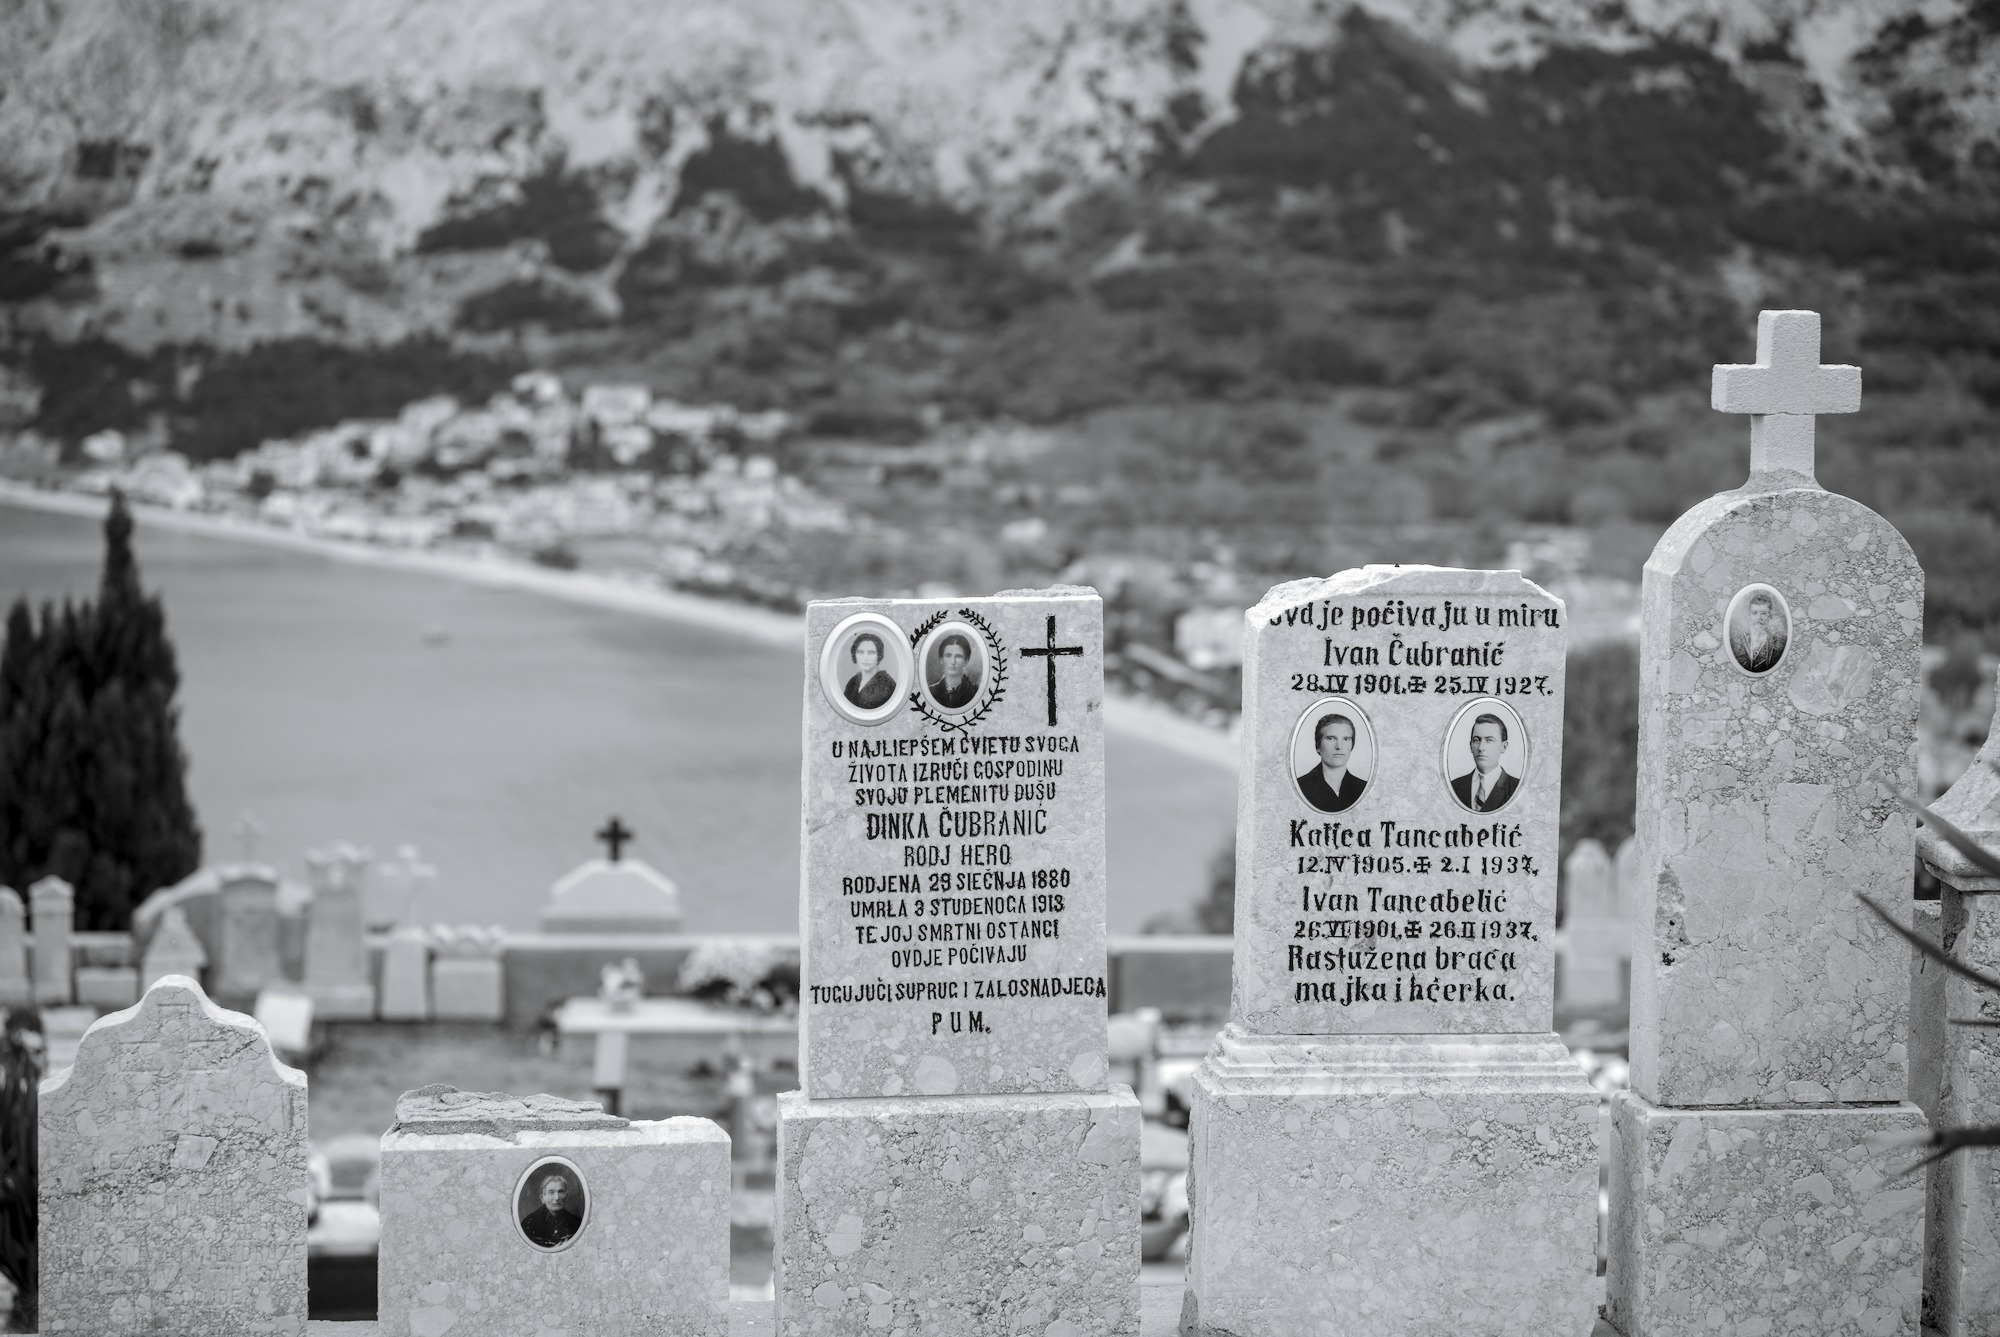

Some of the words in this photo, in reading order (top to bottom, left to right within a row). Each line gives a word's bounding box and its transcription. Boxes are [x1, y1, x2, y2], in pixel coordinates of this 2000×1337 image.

[1474, 605, 1491, 626] u
[1323, 636, 1380, 668] Ivan
[1388, 632, 1506, 668] Čubranić
[1494, 675, 1554, 697] 1927.
[831, 740, 844, 759] U
[1024, 735, 1080, 753] SVOGA
[847, 760, 908, 785] ŽIVOTA
[973, 758, 1063, 783] GOSPODINU
[854, 786, 909, 808] SVOJU
[913, 783, 1010, 806] PLEMENITU
[1014, 779, 1057, 803] DUŠU
[865, 811, 930, 841] DINKA
[938, 802, 1048, 838] ČUBRANIĆ
[903, 844, 951, 868] RODJ
[960, 843, 1013, 867] HERO
[841, 873, 922, 897] RODJENA
[927, 871, 952, 893] 29
[1031, 867, 1071, 890] 1880
[913, 899, 925, 917] 3
[929, 894, 1027, 917] STUDENOGA
[1031, 893, 1066, 914] 1913
[1302, 884, 1359, 914] Ivan
[917, 922, 982, 943] SMRTNI
[986, 918, 1060, 941] OSTANCI
[891, 948, 943, 969] OVDJE
[1294, 974, 1388, 1007] majka
[1392, 976, 1403, 1004] i
